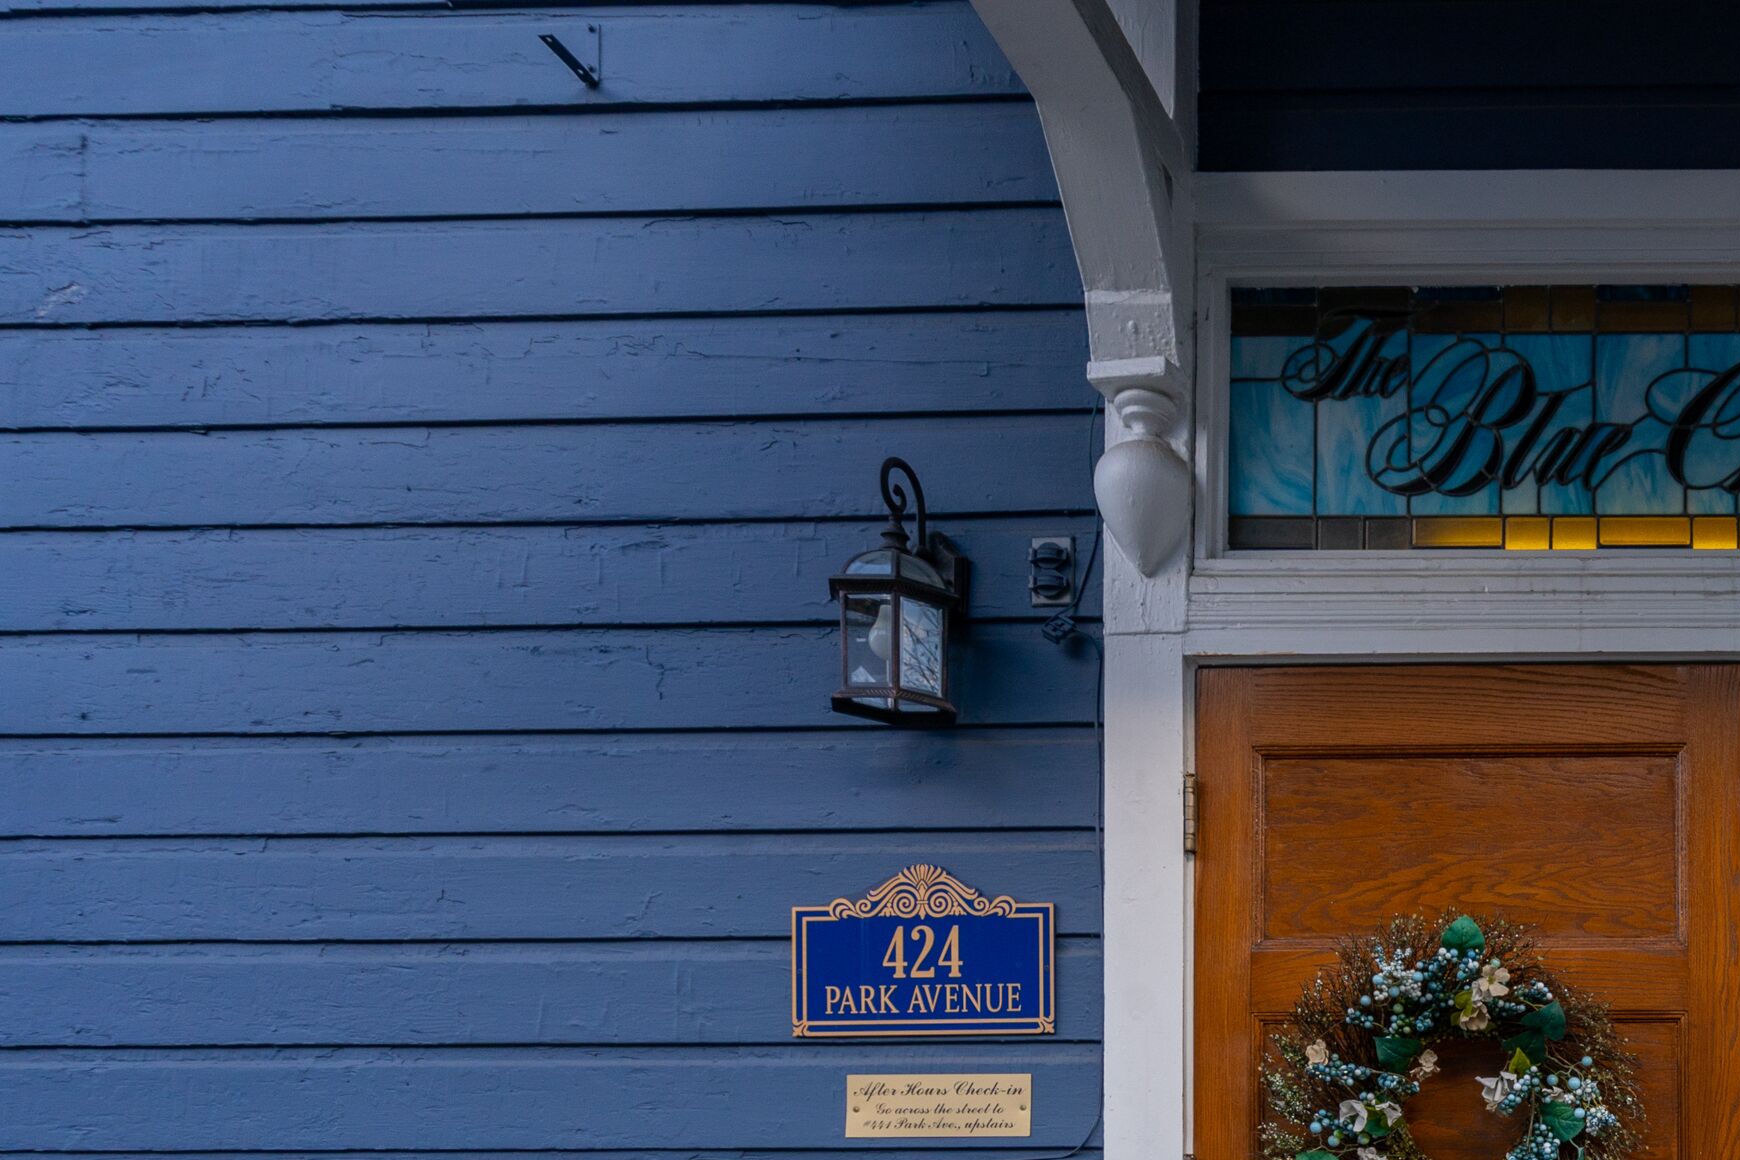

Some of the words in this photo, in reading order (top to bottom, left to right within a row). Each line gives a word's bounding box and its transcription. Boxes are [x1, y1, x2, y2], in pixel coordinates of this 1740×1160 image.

[1281, 306, 1413, 402] The
[1366, 338, 1636, 498] Blue
[883, 925, 963, 979] 424
[825, 984, 900, 1014] PARK
[907, 983, 1022, 1013] AVENUE
[854, 1082, 896, 1101] After
[901, 1081, 949, 1096] Hours
[954, 1080, 1024, 1096] Check-in
[876, 1103, 892, 1114] Go
[894, 1106, 930, 1114] across
[934, 1103, 953, 1114] the
[955, 1103, 989, 1114] street
[992, 1103, 1004, 1114] to
[894, 1117, 925, 1129] Park
[964, 1118, 1014, 1133] upstairs
